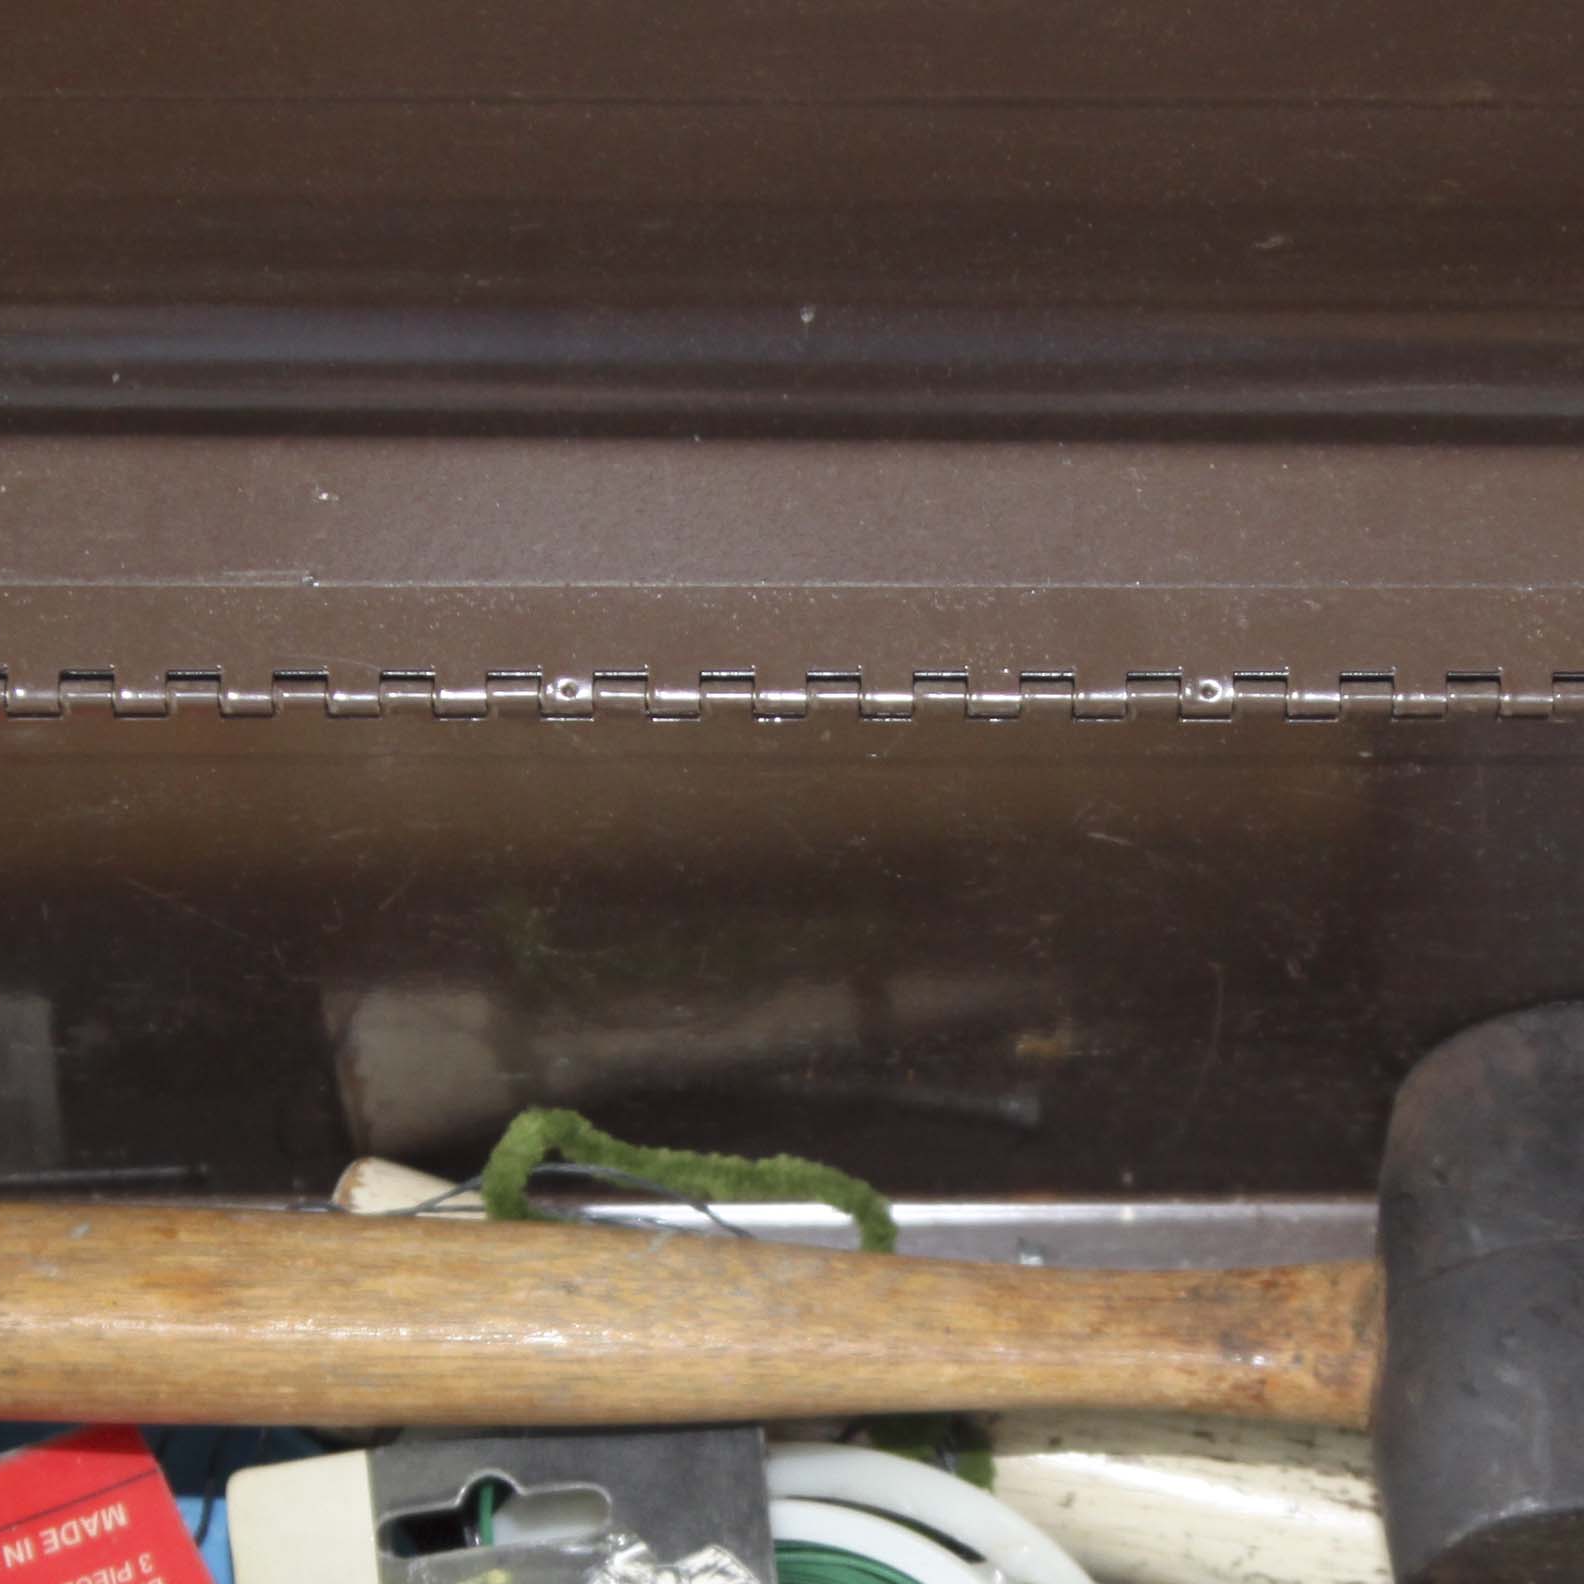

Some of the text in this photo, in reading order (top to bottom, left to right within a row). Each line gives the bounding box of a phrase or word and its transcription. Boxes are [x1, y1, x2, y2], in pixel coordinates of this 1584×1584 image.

[38, 1503, 128, 1555] MADE
[2, 1537, 34, 1569] IN
[138, 1552, 154, 1574] 3
